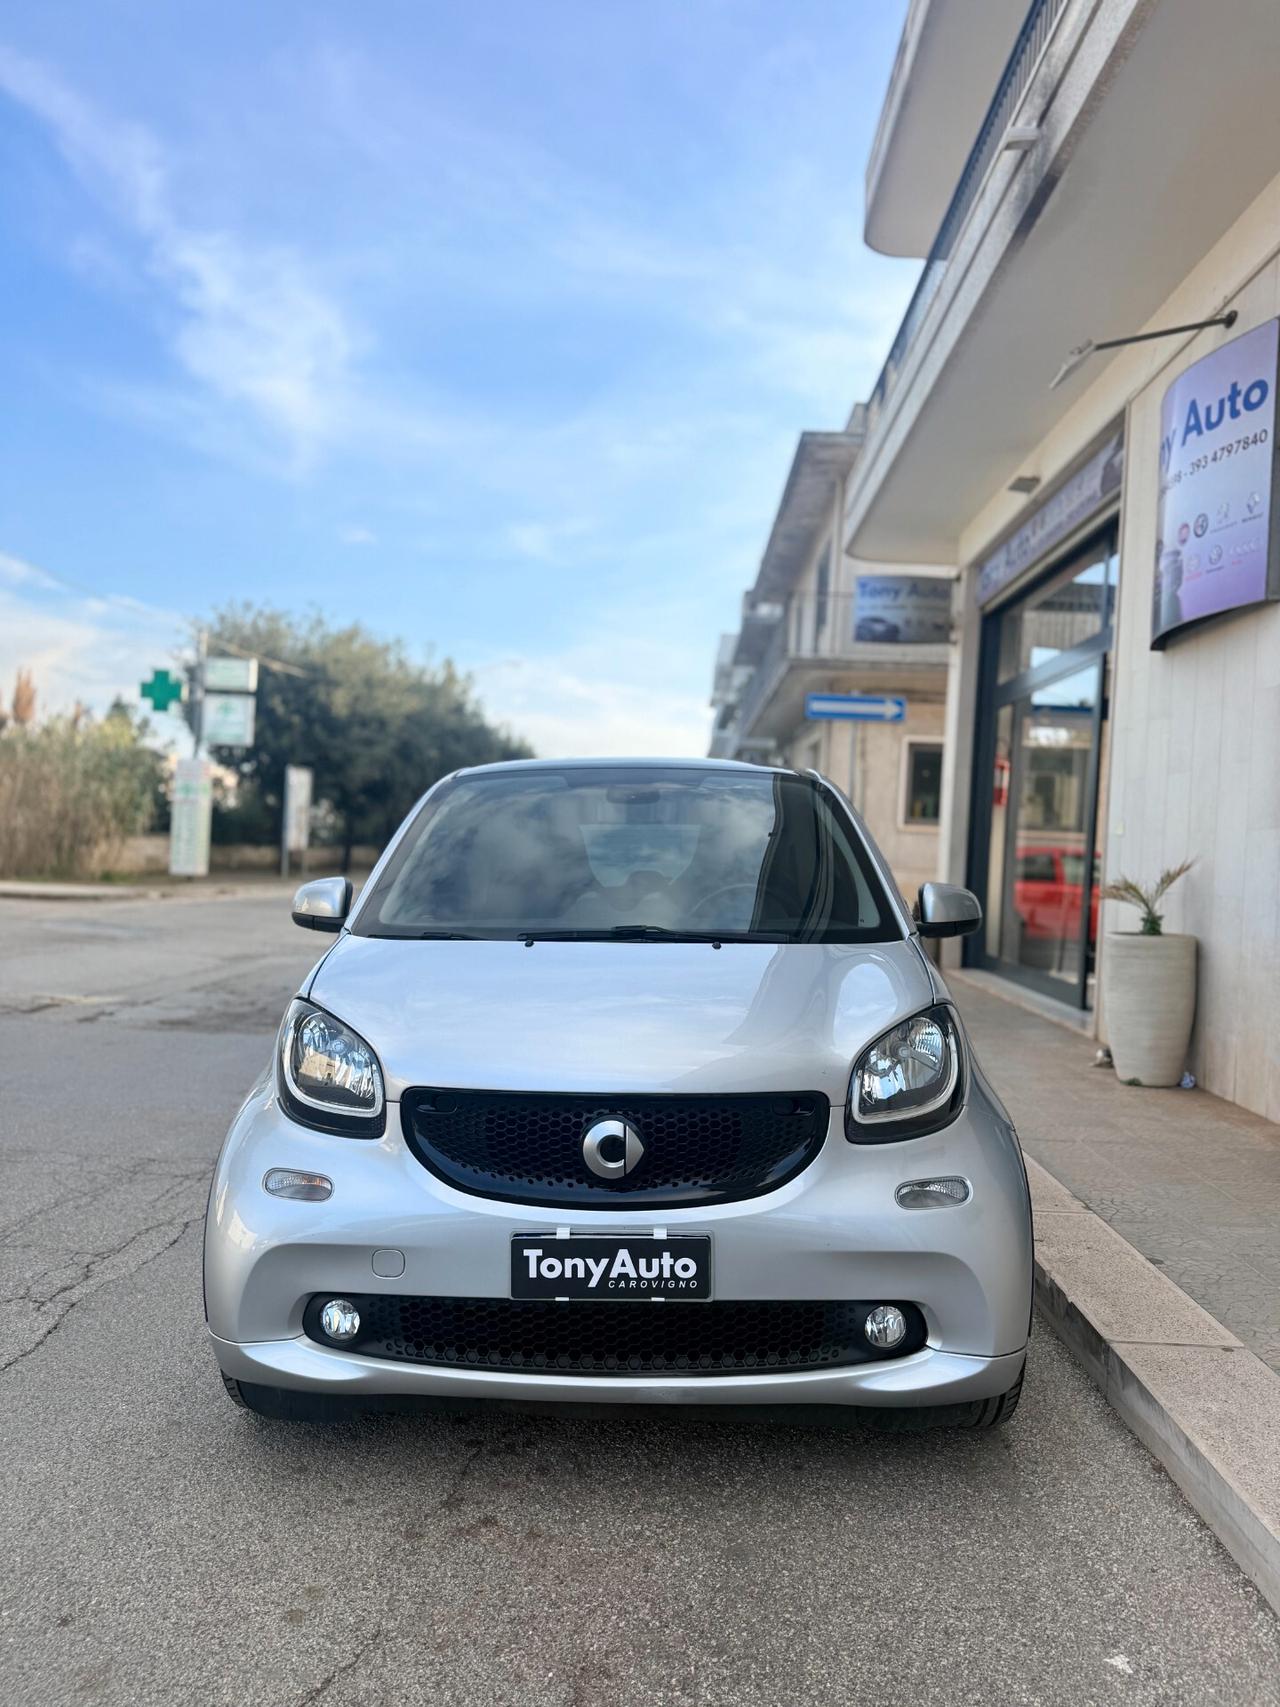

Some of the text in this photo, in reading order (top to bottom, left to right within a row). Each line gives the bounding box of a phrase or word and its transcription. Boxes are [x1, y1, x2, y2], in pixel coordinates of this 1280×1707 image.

[1181, 379, 1269, 446] Auto
[1189, 428, 1268, 476] 393 4797840
[608, 1280, 698, 1289] CAROVIGNO
